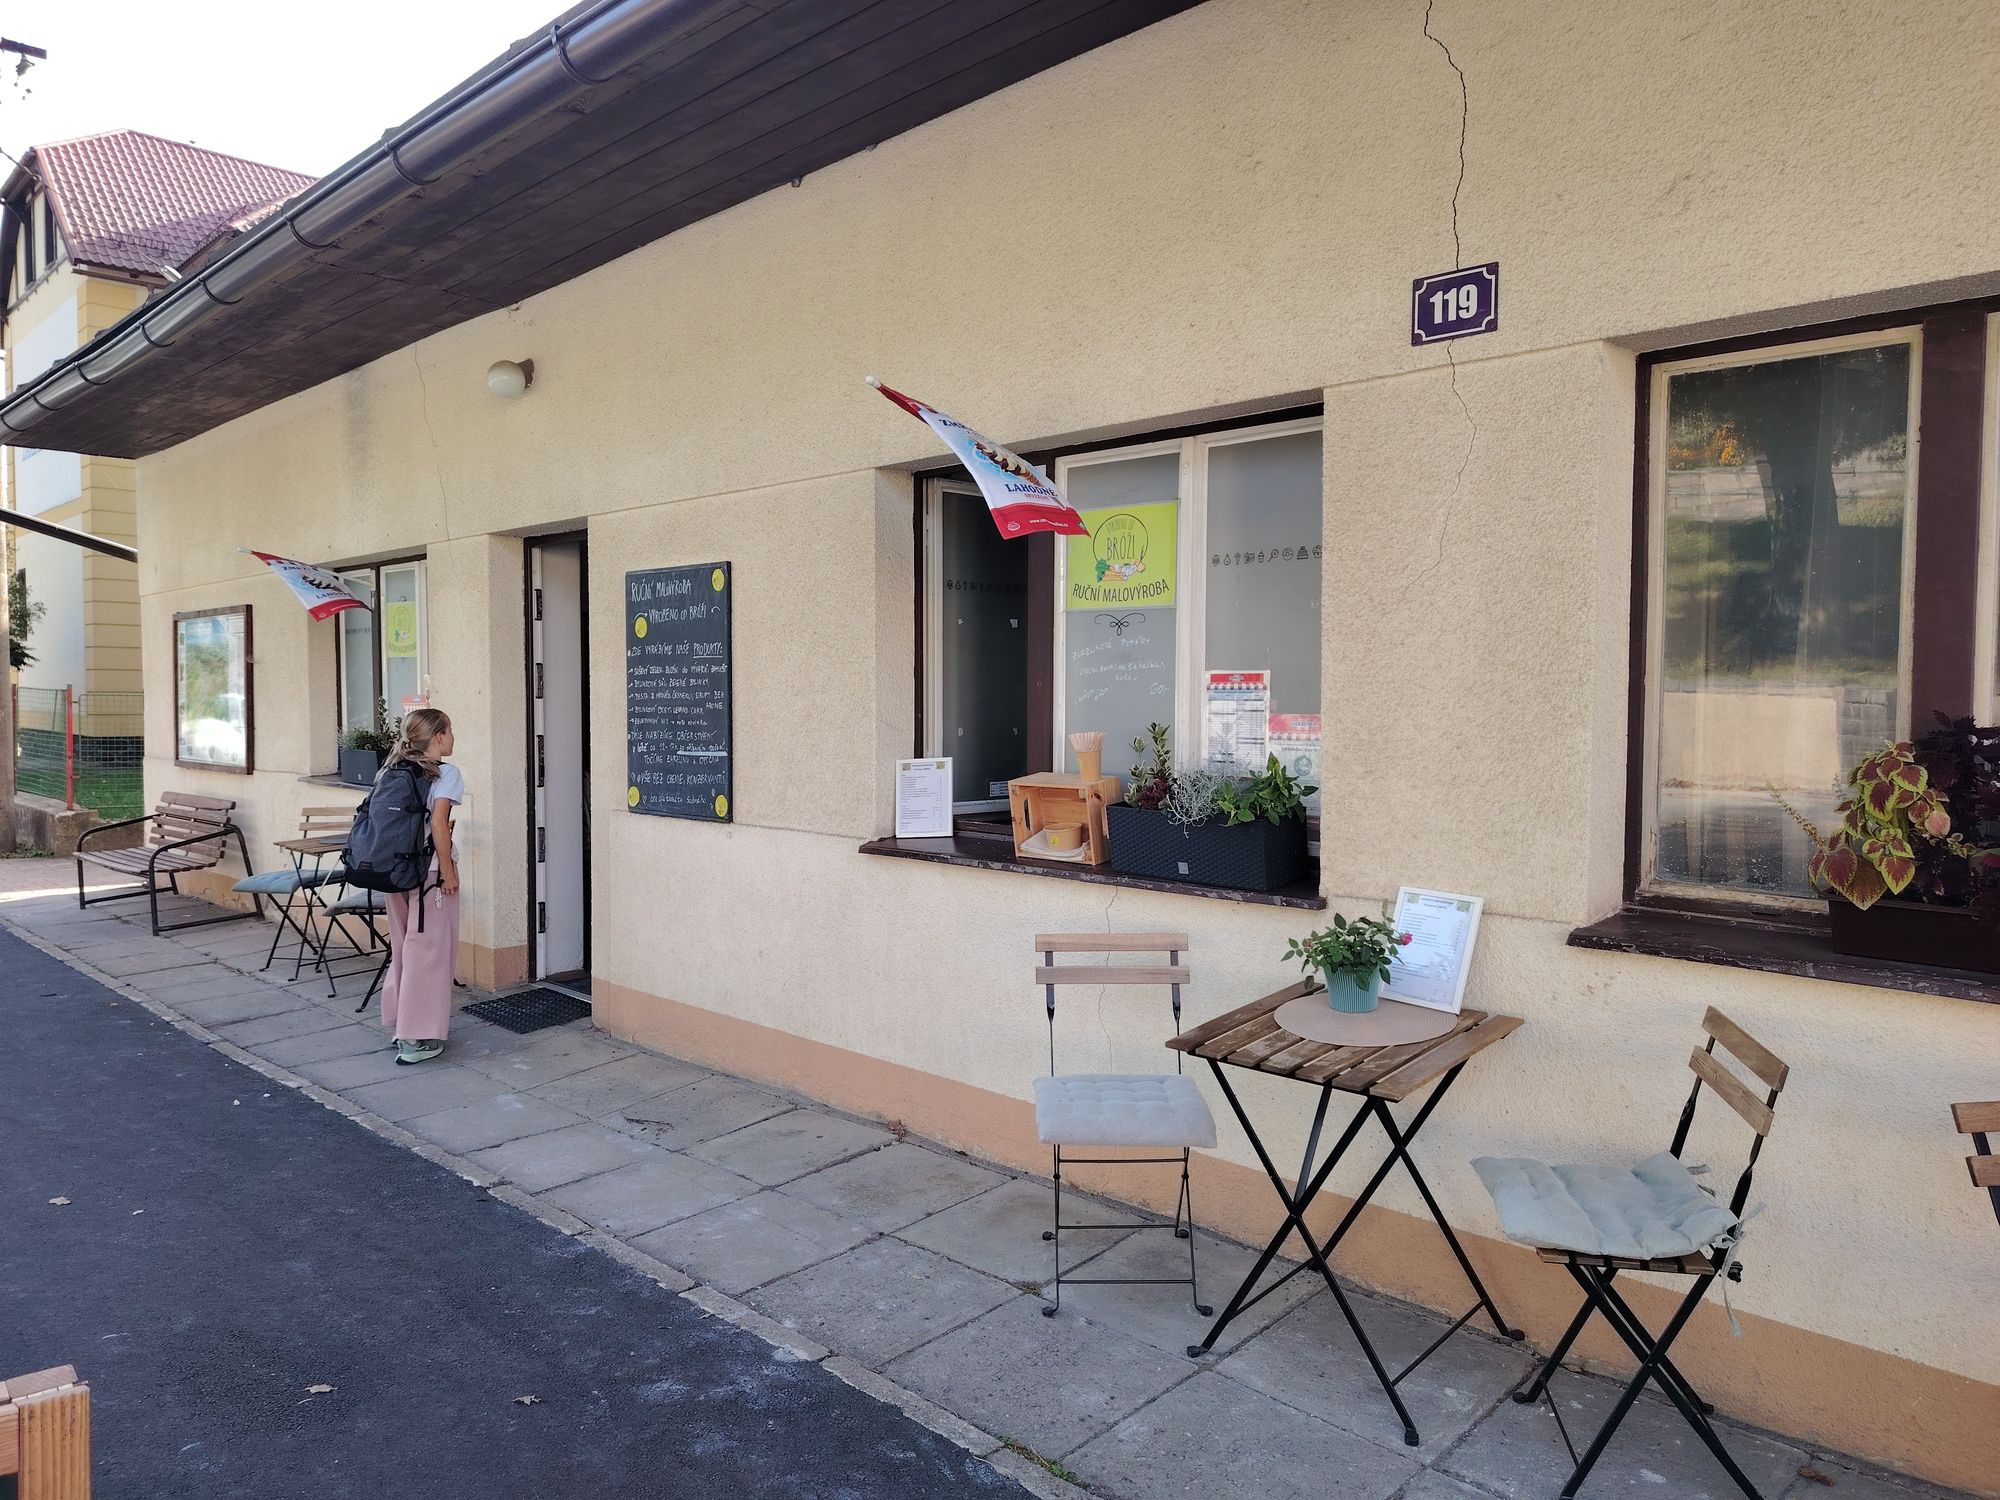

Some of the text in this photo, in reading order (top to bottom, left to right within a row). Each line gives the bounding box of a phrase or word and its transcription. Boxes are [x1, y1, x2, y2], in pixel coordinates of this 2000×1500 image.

[1429, 284, 1478, 325] 119
[1107, 532, 1135, 561] BRÓŽI
[1072, 578, 1170, 602] RUČNÍ MALOVÝROBA
